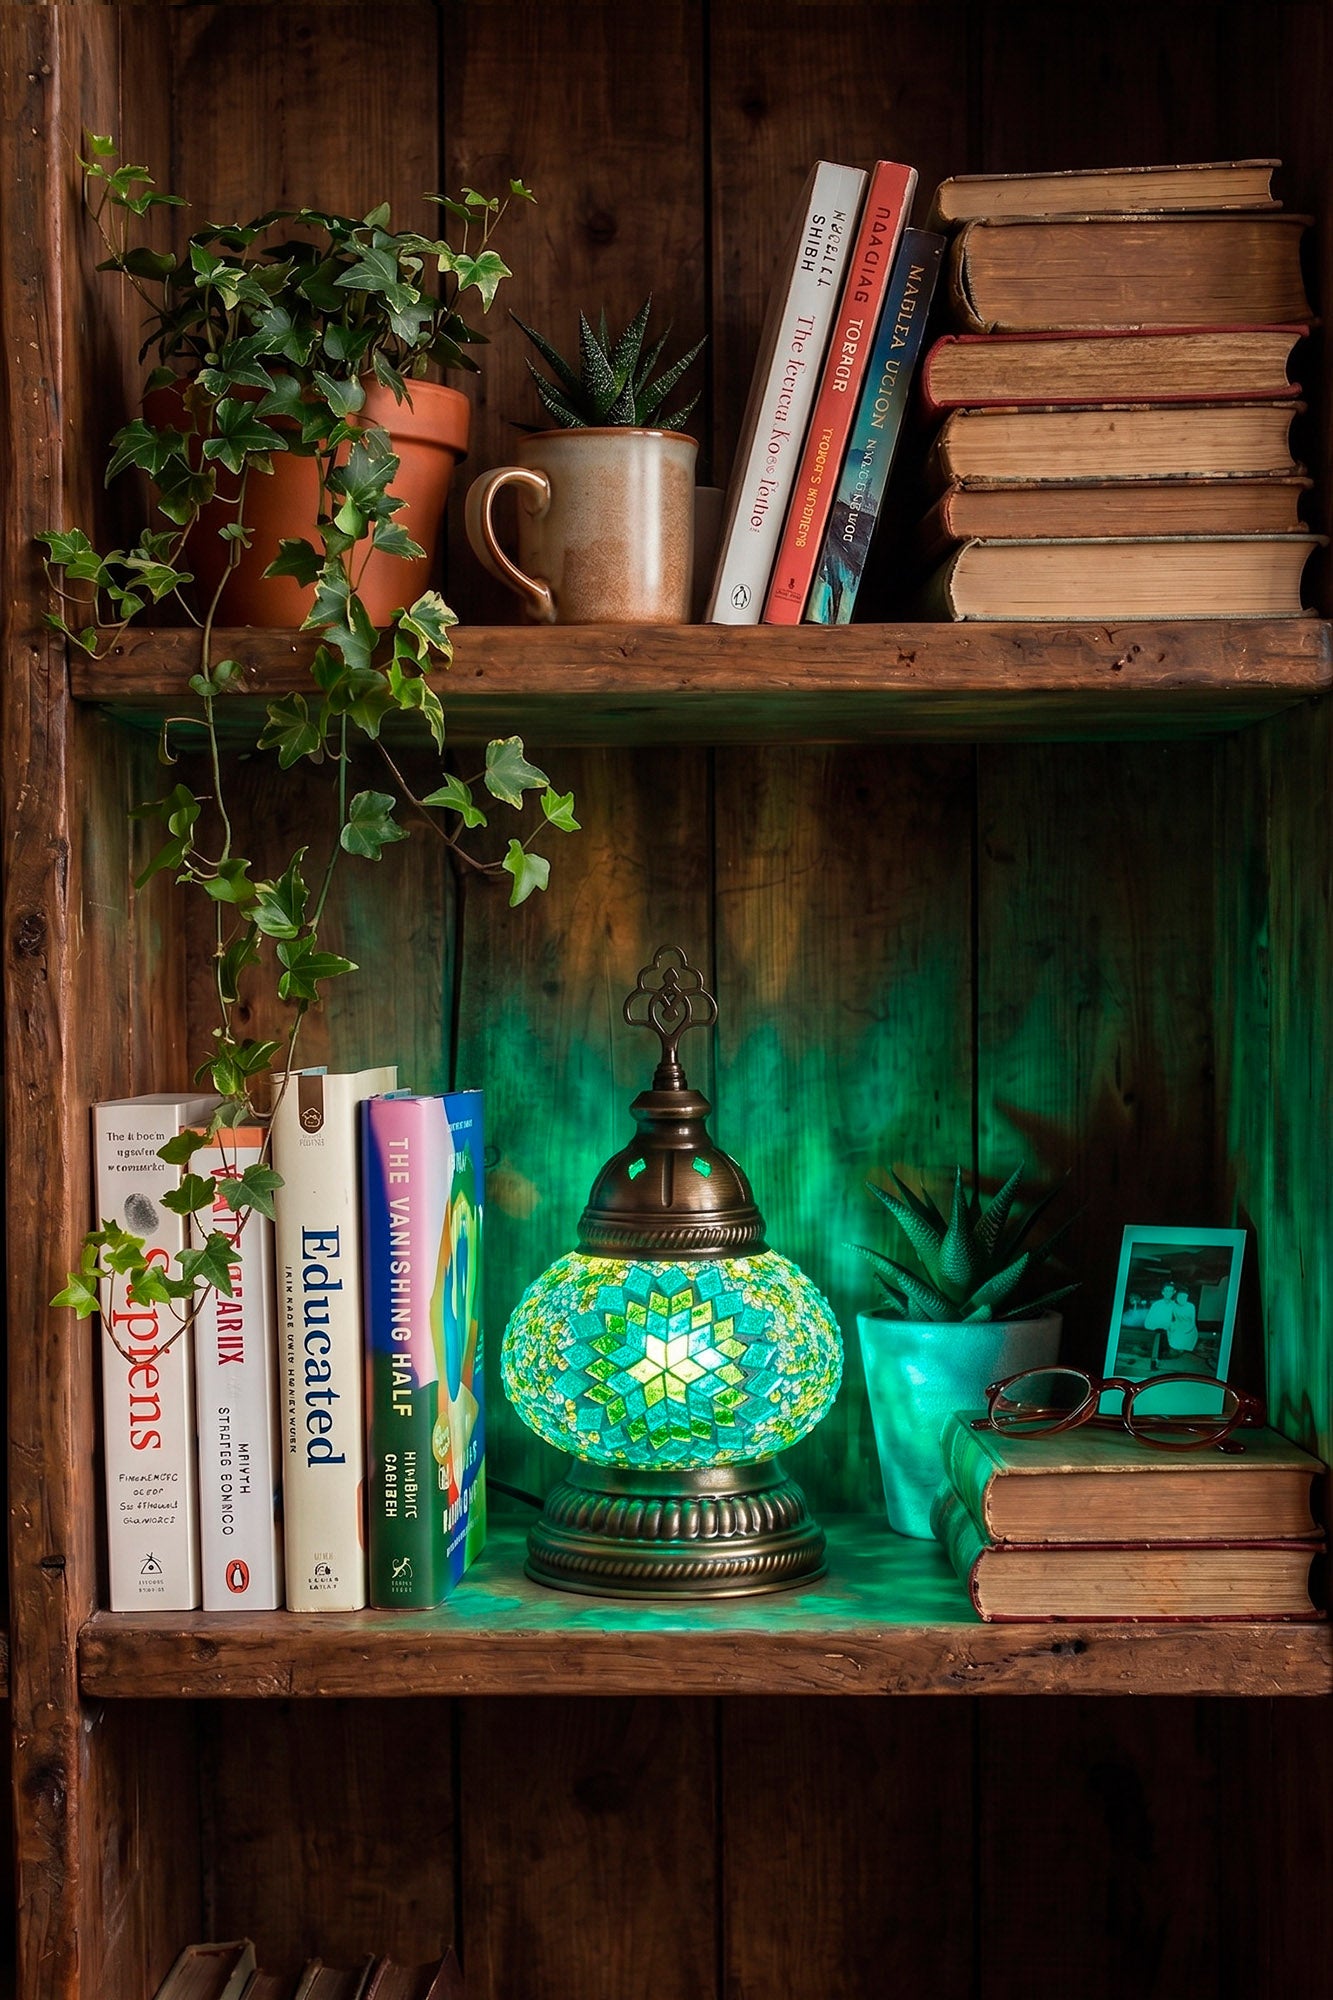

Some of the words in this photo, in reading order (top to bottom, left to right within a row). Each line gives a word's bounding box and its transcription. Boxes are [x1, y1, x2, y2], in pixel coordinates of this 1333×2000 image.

[801, 214, 826, 272] SHIBH
[791, 315, 815, 353] The
[106, 1132, 125, 1142] The
[389, 1138, 409, 1184] THE
[389, 1196, 412, 1341] VANISHING
[301, 1225, 346, 1468] Educated
[392, 1353, 412, 1417] HALF
